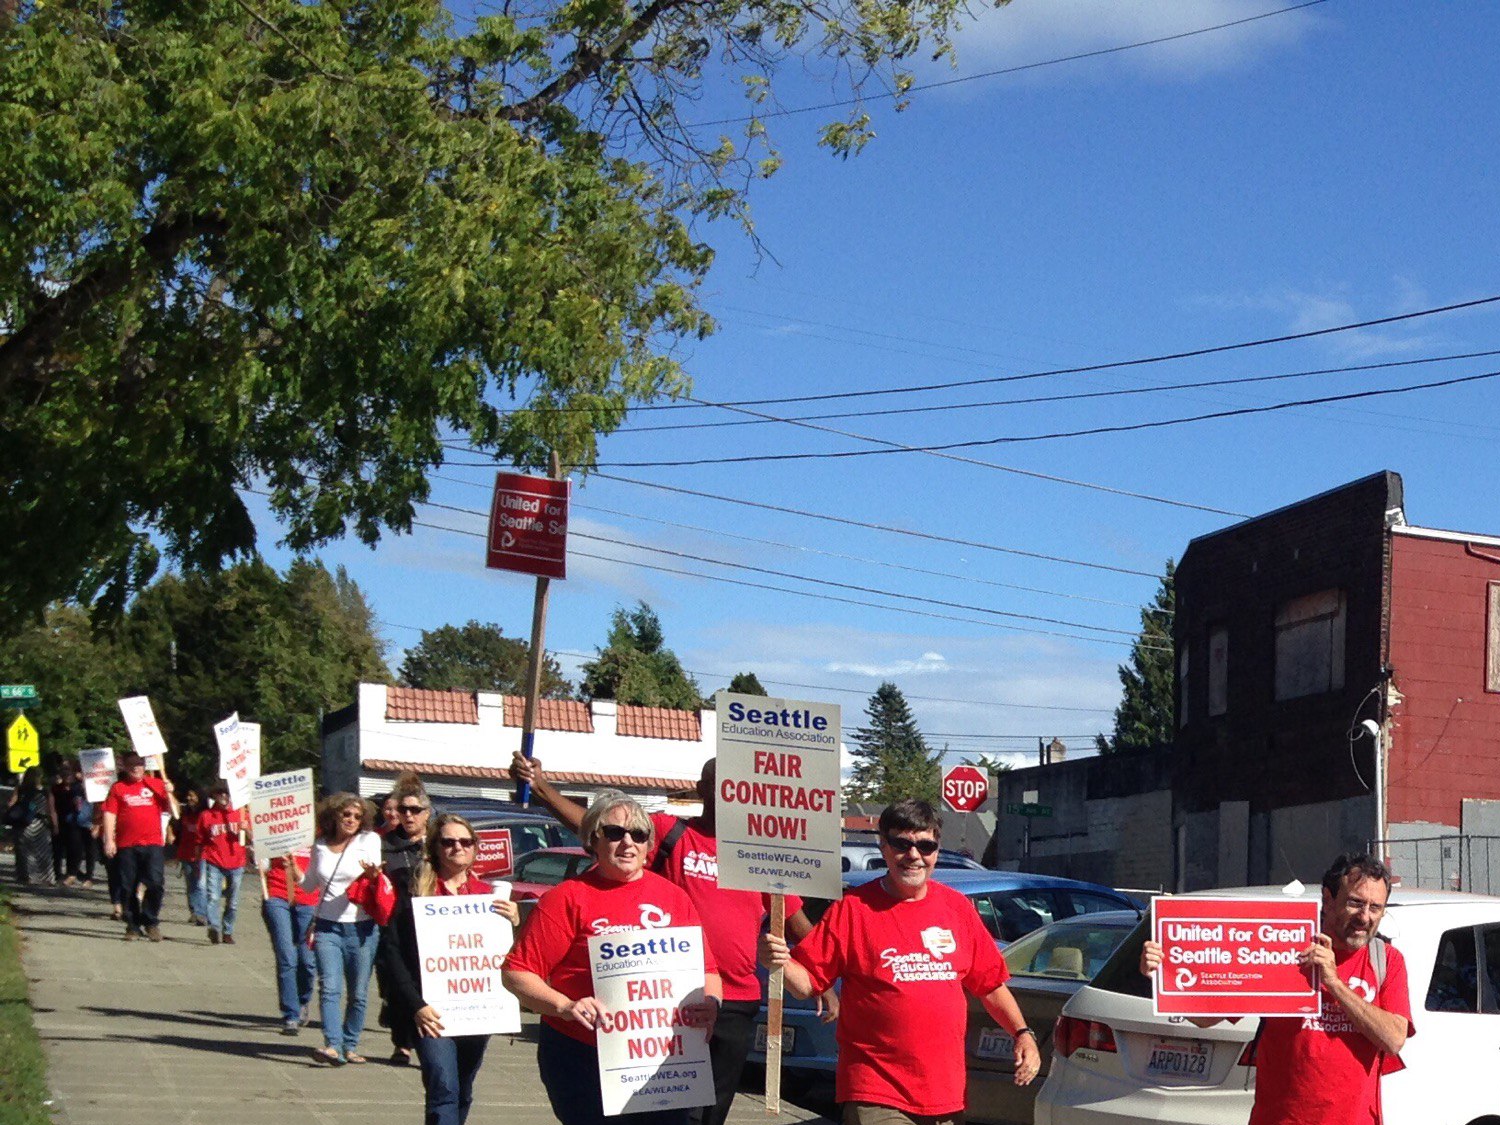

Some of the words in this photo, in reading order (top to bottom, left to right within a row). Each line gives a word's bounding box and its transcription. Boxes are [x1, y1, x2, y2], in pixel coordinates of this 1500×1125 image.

[501, 494, 540, 513] United
[544, 503, 561, 516] for
[500, 512, 543, 532] Seattle
[728, 702, 828, 731] Seattle
[721, 722, 774, 739] Education
[775, 729, 835, 744] Association
[754, 750, 802, 778] FAIR
[254, 774, 306, 790] Seattle
[946, 780, 985, 798] STOP
[270, 795, 295, 808] FAIR
[721, 779, 836, 813] CONTRACT
[254, 804, 312, 824] CONTRACT
[268, 820, 299, 835] NOW!
[747, 813, 807, 841] NOW!
[479, 842, 504, 851] Great
[475, 852, 505, 862] chools
[737, 849, 821, 868] SeattleWEA.org
[748, 866, 811, 880] SEA/WEA/NEA
[425, 901, 498, 916] Seattle
[448, 933, 484, 949] FAIR
[1167, 925, 1222, 942] United
[1228, 928, 1253, 942] for
[1258, 925, 1306, 943] Great
[600, 937, 691, 960] Seattle
[1169, 947, 1231, 964] Seattle
[596, 960, 643, 973] Education
[880, 948, 930, 968] Seattle
[892, 962, 952, 973] Education
[447, 977, 491, 994] NOW!
[893, 971, 957, 983] Association
[626, 978, 673, 1001] FAIR
[1302, 1018, 1354, 1032] Associat
[627, 1035, 684, 1059] NOW!
[620, 1069, 697, 1083] SeattleWEA.org
